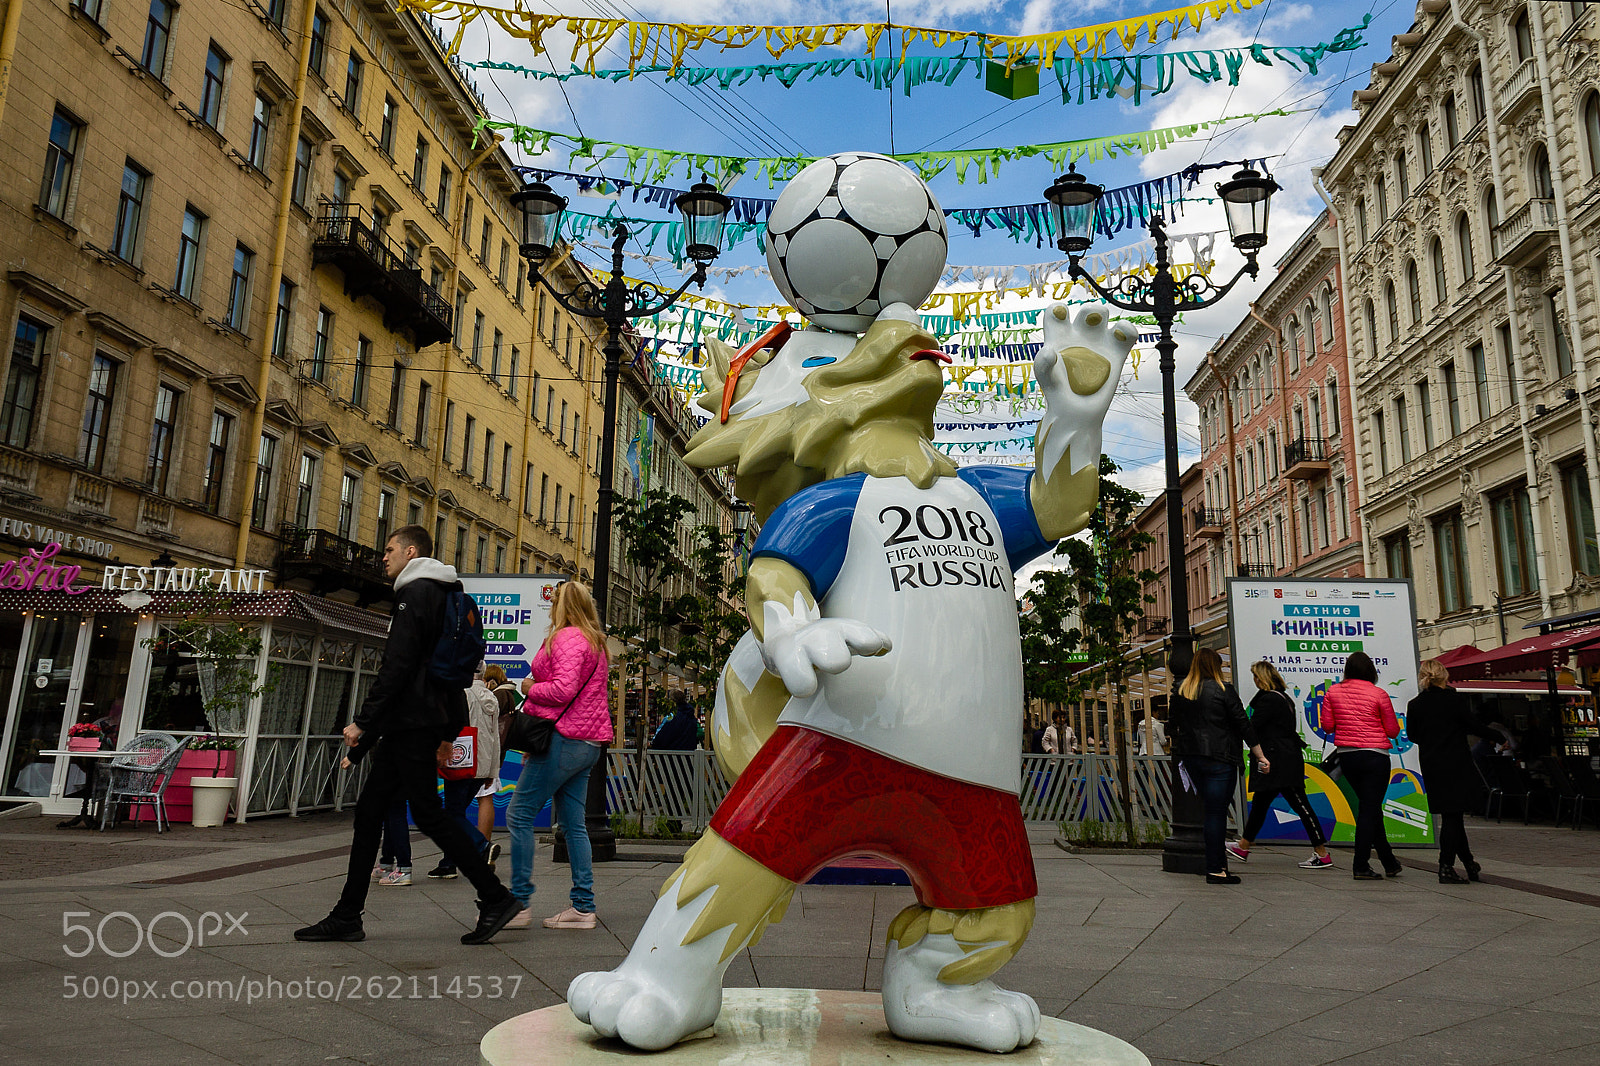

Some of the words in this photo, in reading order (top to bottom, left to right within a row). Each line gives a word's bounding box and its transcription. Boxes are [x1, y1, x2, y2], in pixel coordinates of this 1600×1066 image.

[0, 517, 33, 540] EUS
[35, 525, 74, 550] VAPE
[76, 536, 113, 558] SHOP
[878, 504, 995, 547] 2018
[885, 546, 921, 564] FIFA
[922, 544, 975, 558] WORLD
[977, 548, 999, 563] CUP
[102, 565, 270, 595] RESTAURANT
[890, 560, 1007, 593] RUSSIA
[1292, 605, 1351, 616] летние
[1271, 618, 1375, 639] КНИЖНЫЕ
[1278, 656, 1302, 665] МАЯ
[1315, 657, 1327, 665] 17
